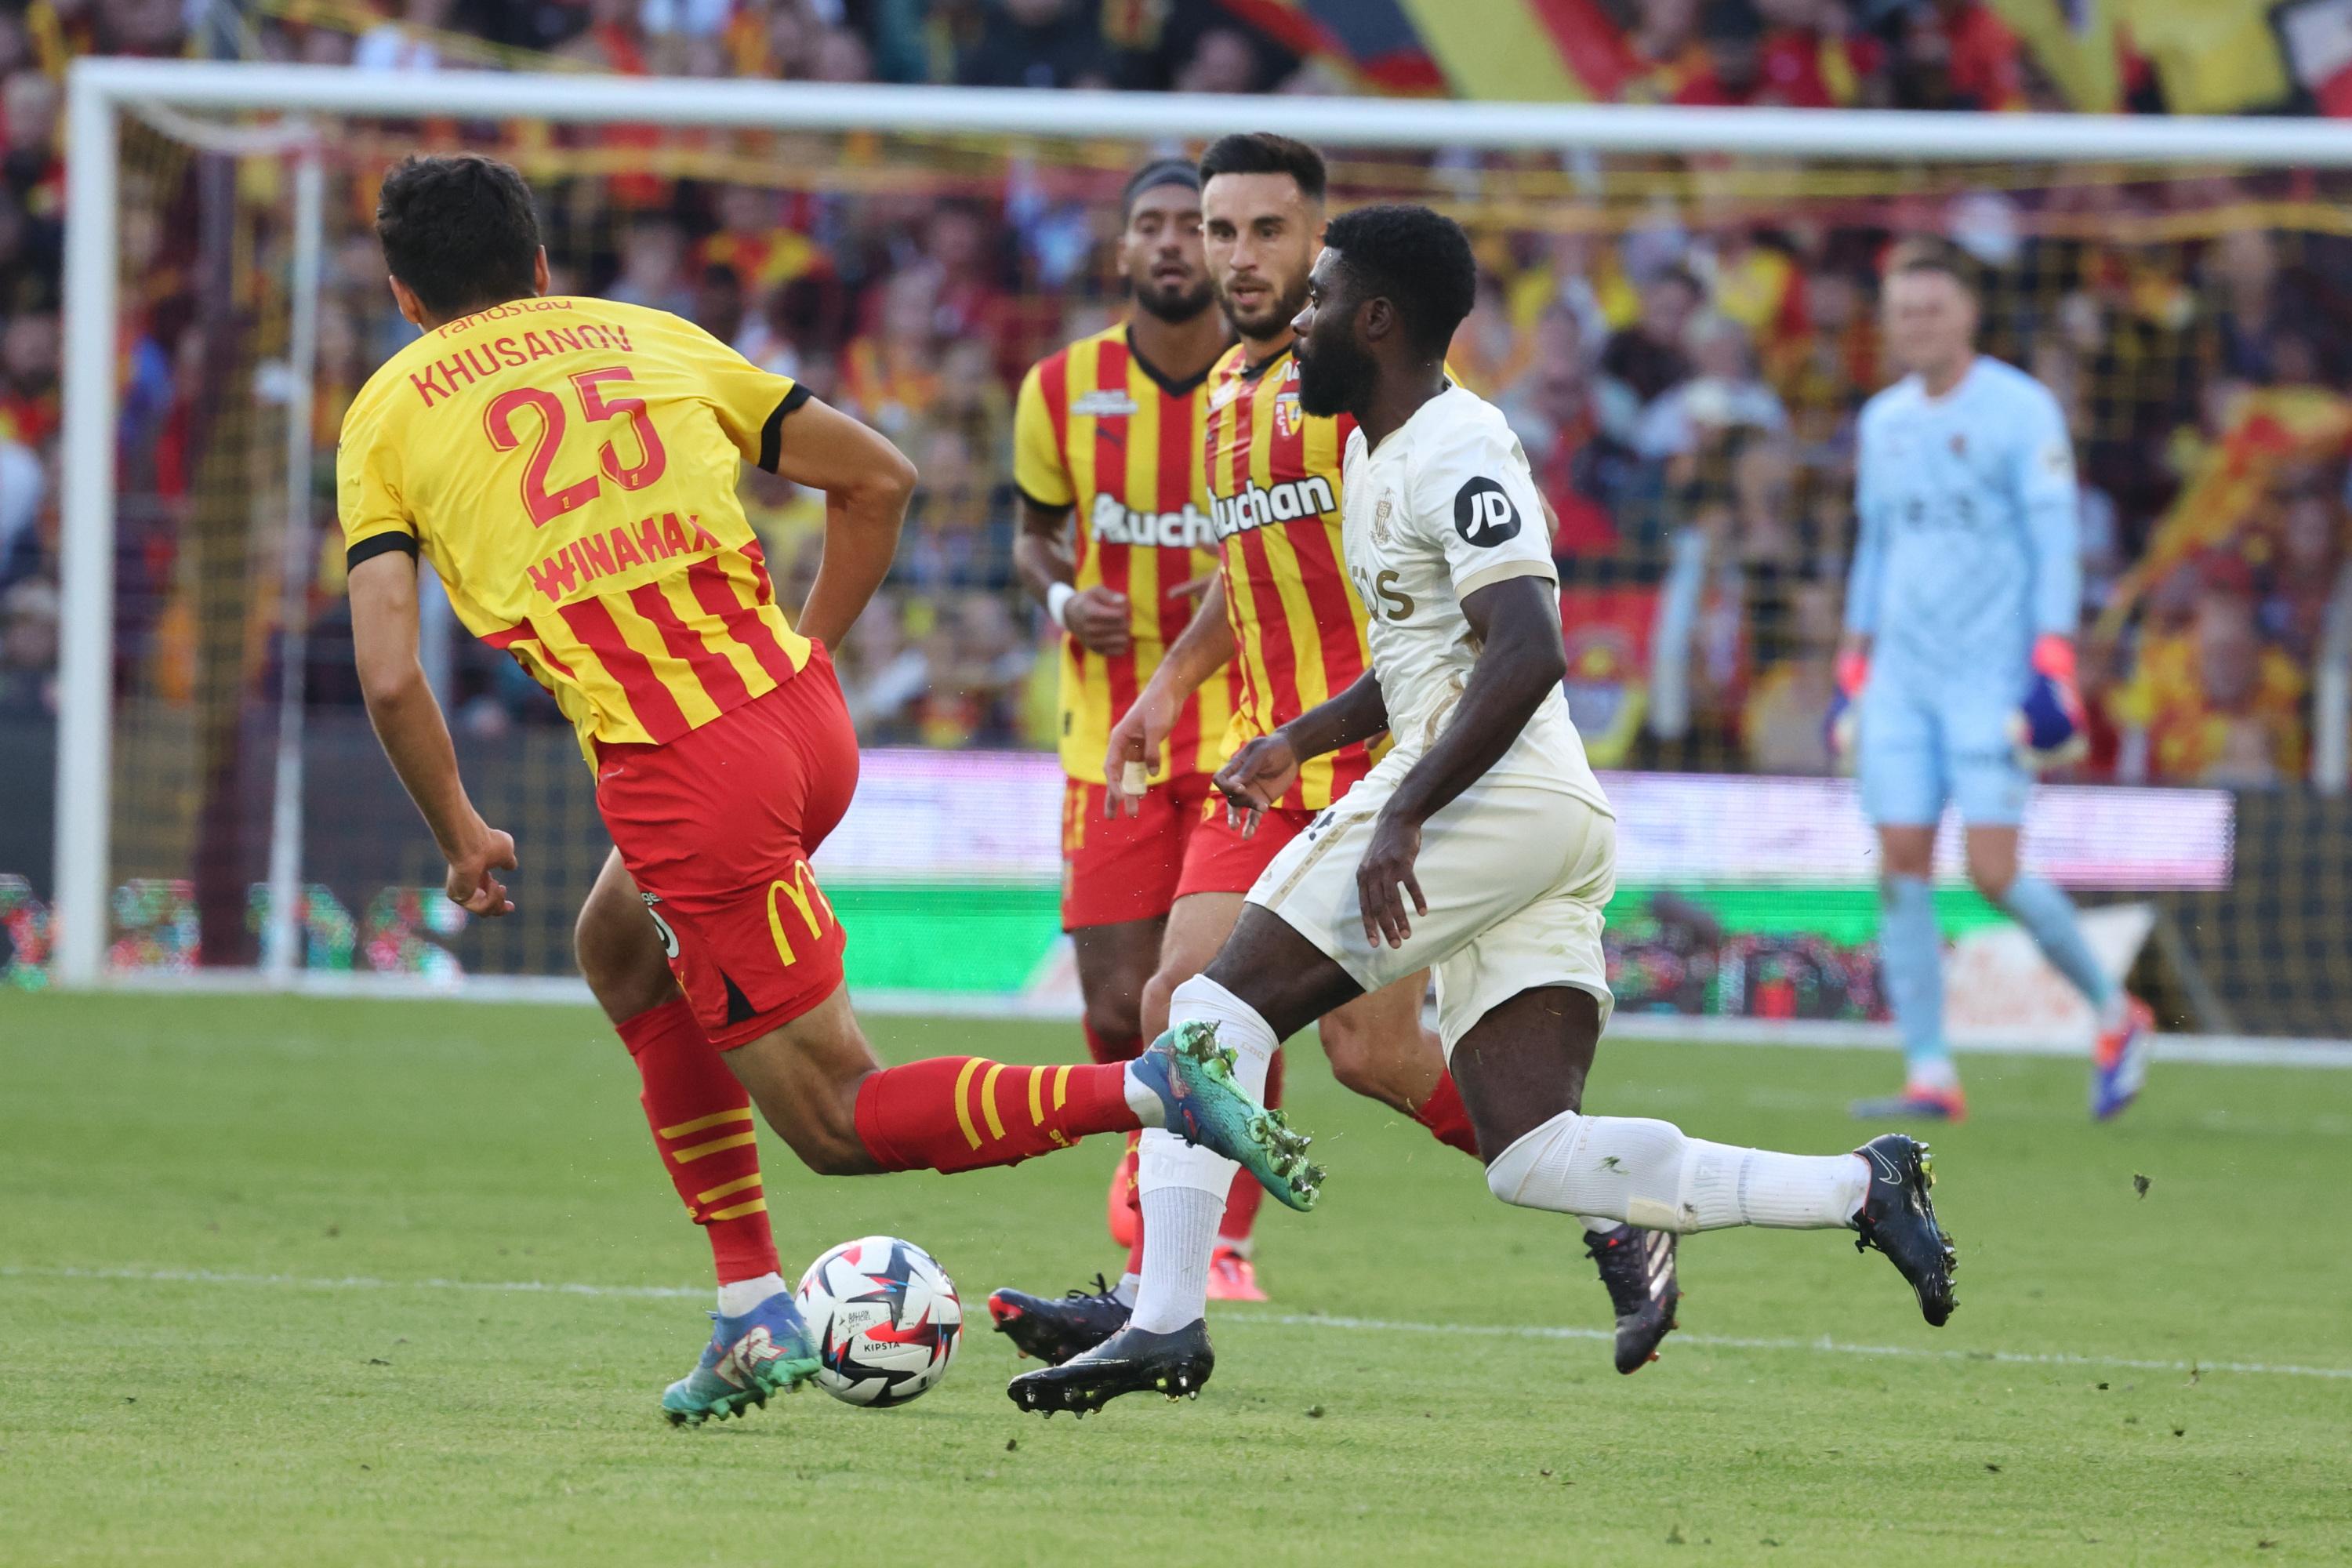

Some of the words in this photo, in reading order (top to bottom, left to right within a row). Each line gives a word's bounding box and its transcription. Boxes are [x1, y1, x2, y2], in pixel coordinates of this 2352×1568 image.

[409, 325, 633, 408] KHUSANOV
[483, 366, 666, 528] 25
[1091, 492, 1214, 548] Auch
[1207, 474, 1338, 541] uchan
[1466, 490, 1512, 539] JD
[526, 512, 722, 603] WINAMAX
[864, 1341, 900, 1352] KIPSTA
